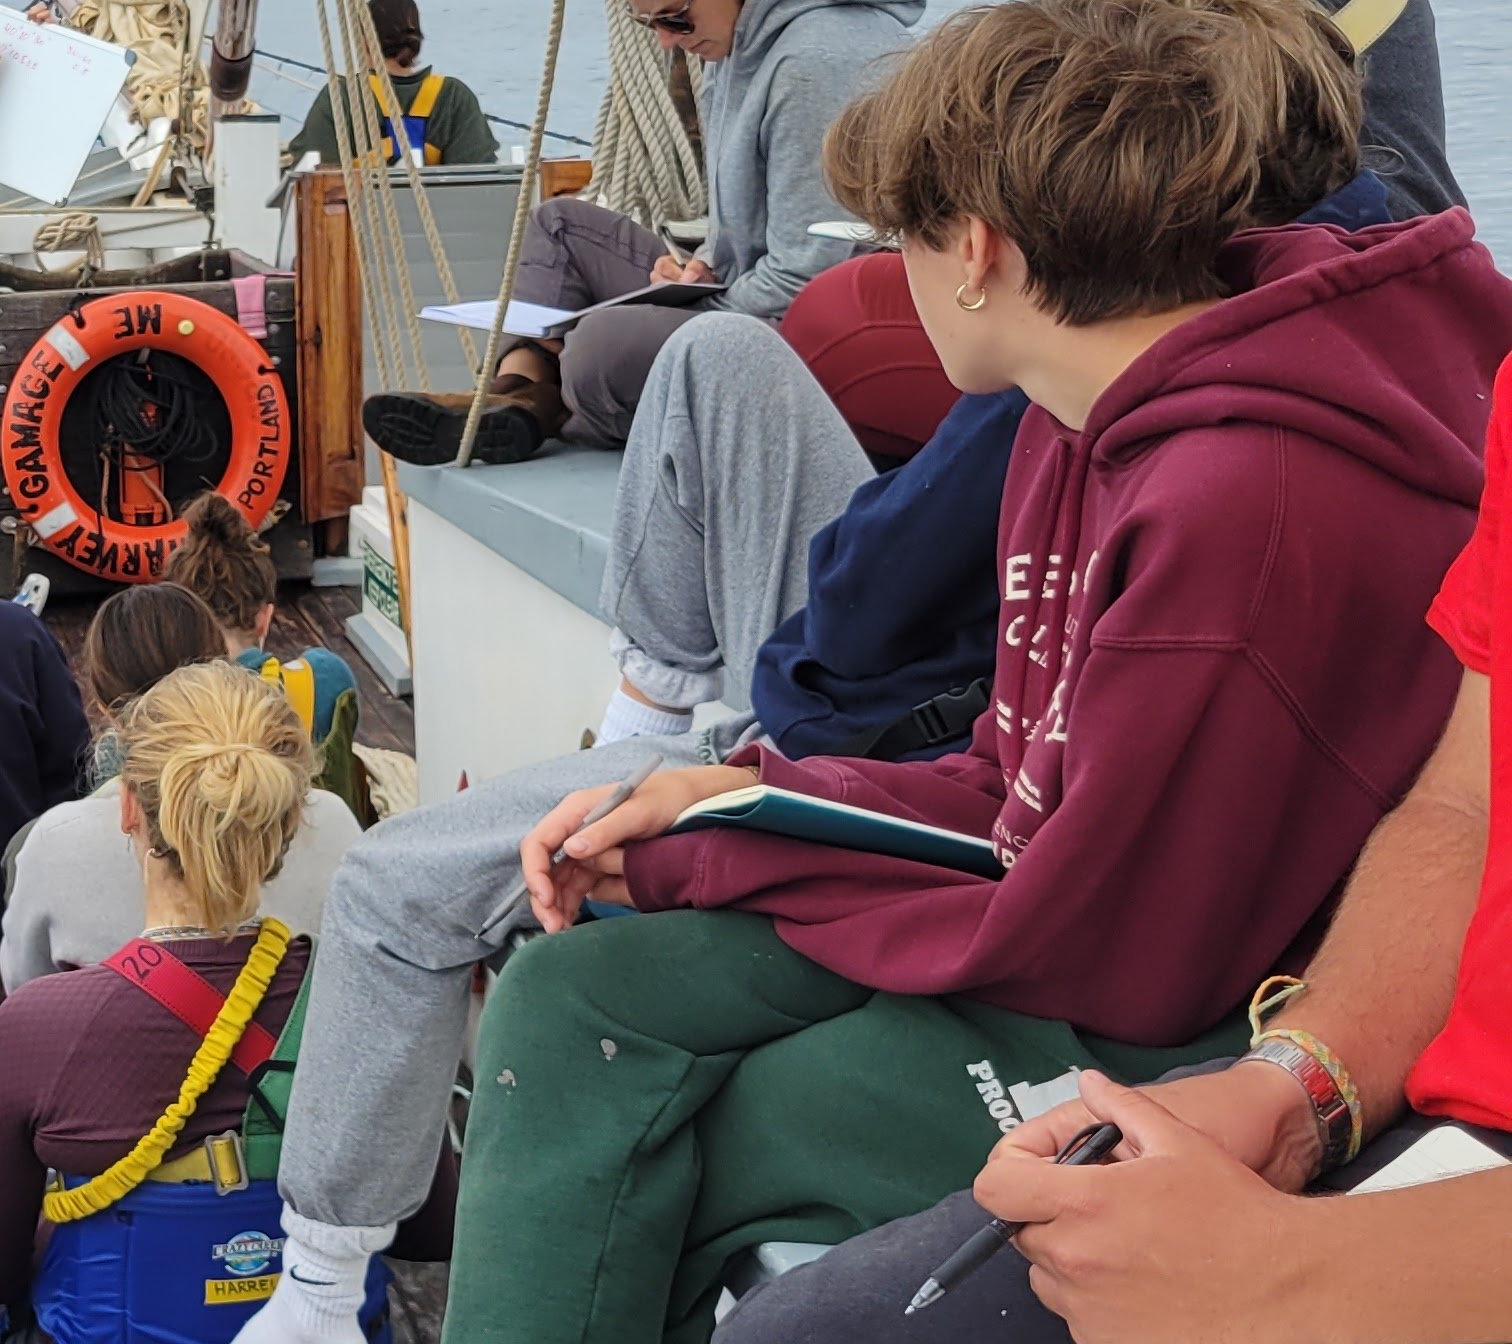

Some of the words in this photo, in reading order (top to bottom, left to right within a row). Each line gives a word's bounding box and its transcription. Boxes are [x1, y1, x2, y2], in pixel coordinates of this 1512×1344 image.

[114, 304, 162, 339] ME
[9, 349, 65, 499] GAMAGE
[237, 384, 281, 509] PORTLAND
[121, 944, 162, 979] 20
